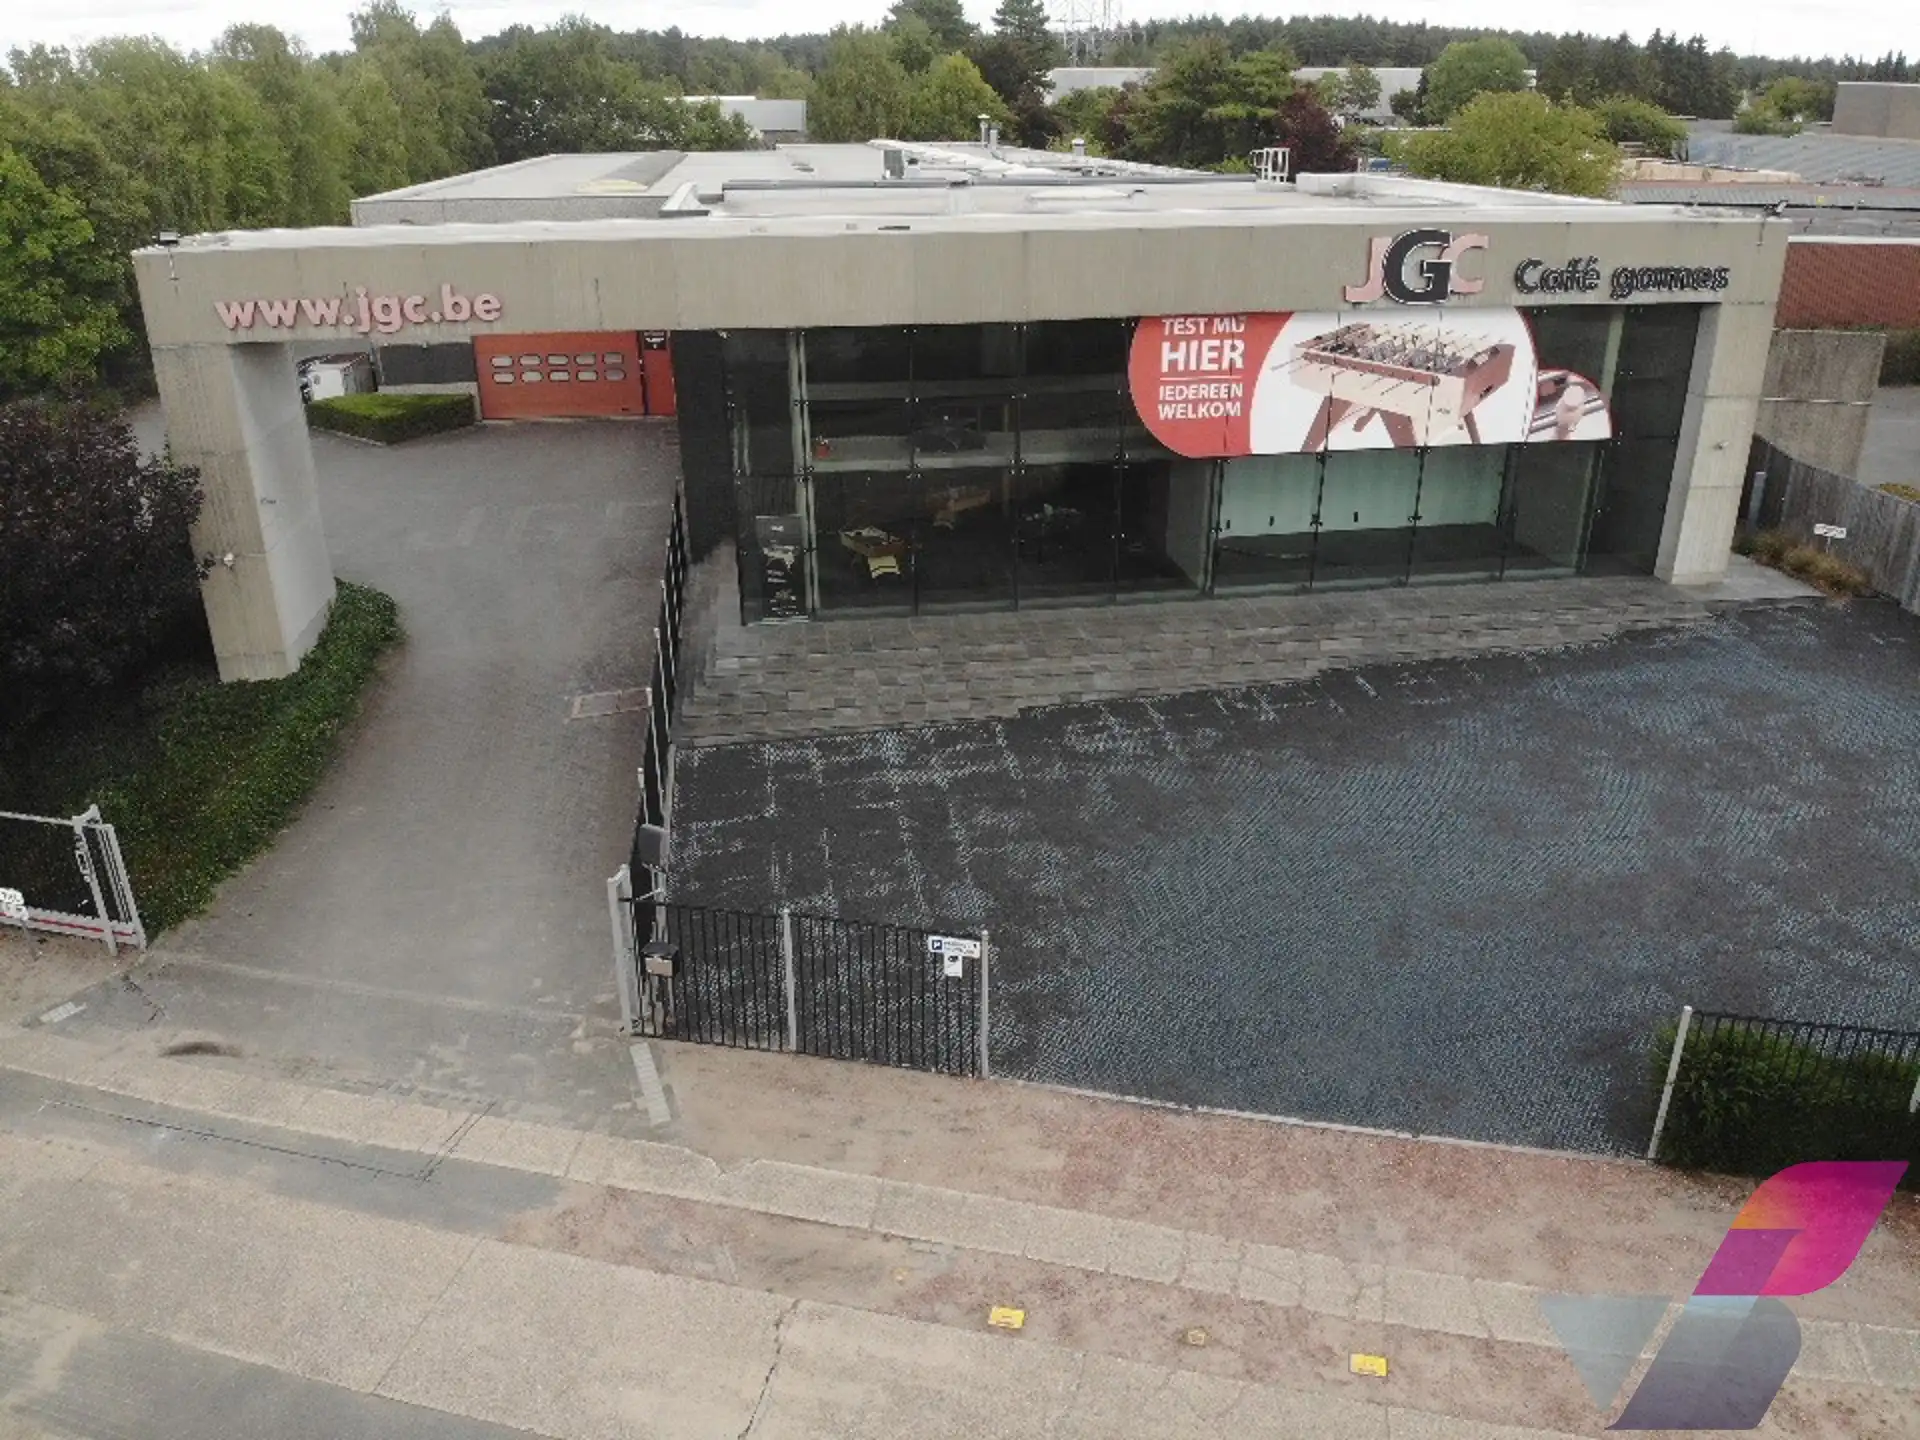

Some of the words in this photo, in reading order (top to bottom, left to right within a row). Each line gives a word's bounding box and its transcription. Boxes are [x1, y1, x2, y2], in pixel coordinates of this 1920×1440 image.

[1345, 228, 1489, 304] JGC
[1514, 256, 1601, 294] Café
[1610, 262, 1731, 299] games
[215, 284, 503, 334] www.jgc.be
[1162, 317, 1208, 336] TEST
[1161, 339, 1245, 373] HIER
[1159, 382, 1243, 401] IEDEREEN
[1158, 401, 1241, 420] WELKOM
